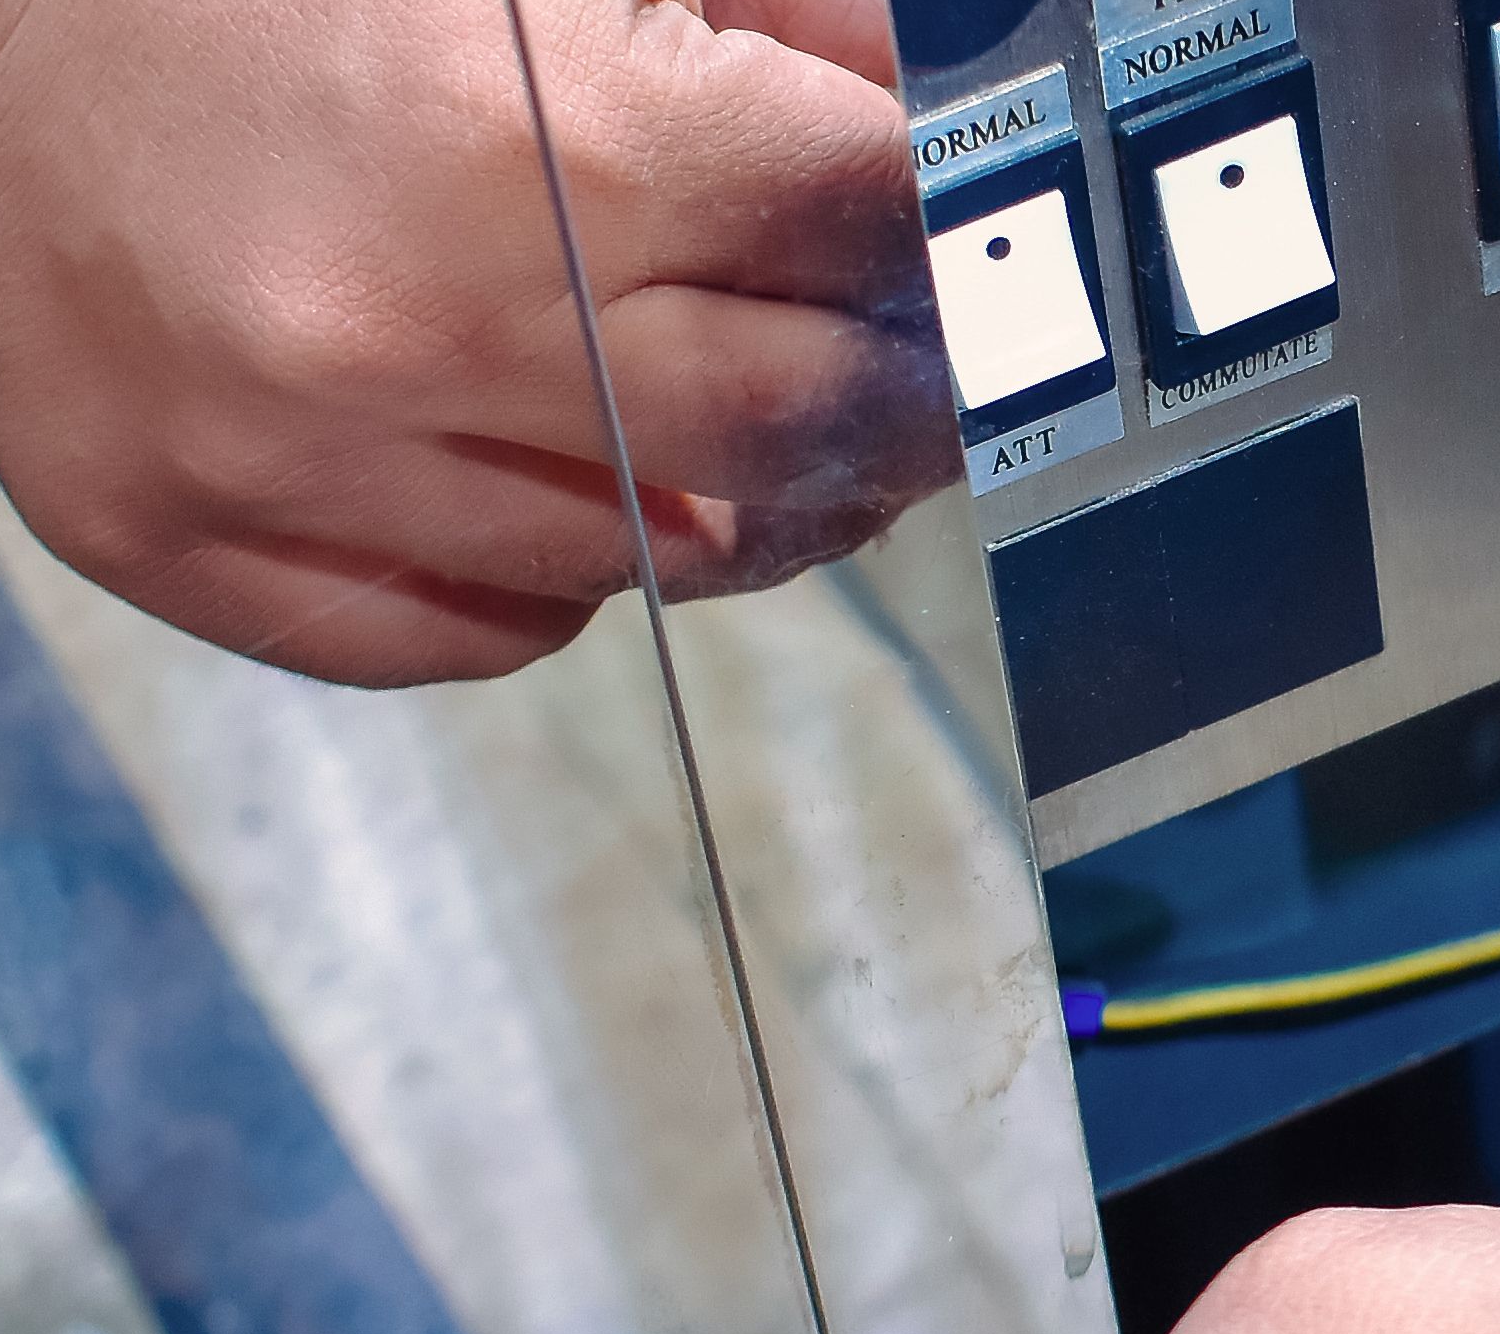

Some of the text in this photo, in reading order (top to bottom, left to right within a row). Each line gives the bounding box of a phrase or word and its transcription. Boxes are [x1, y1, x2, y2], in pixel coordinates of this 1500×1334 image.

[1124, 8, 1271, 84] NORMAL
[1161, 330, 1319, 410] COMMUTATE
[991, 426, 1056, 475] ATT
